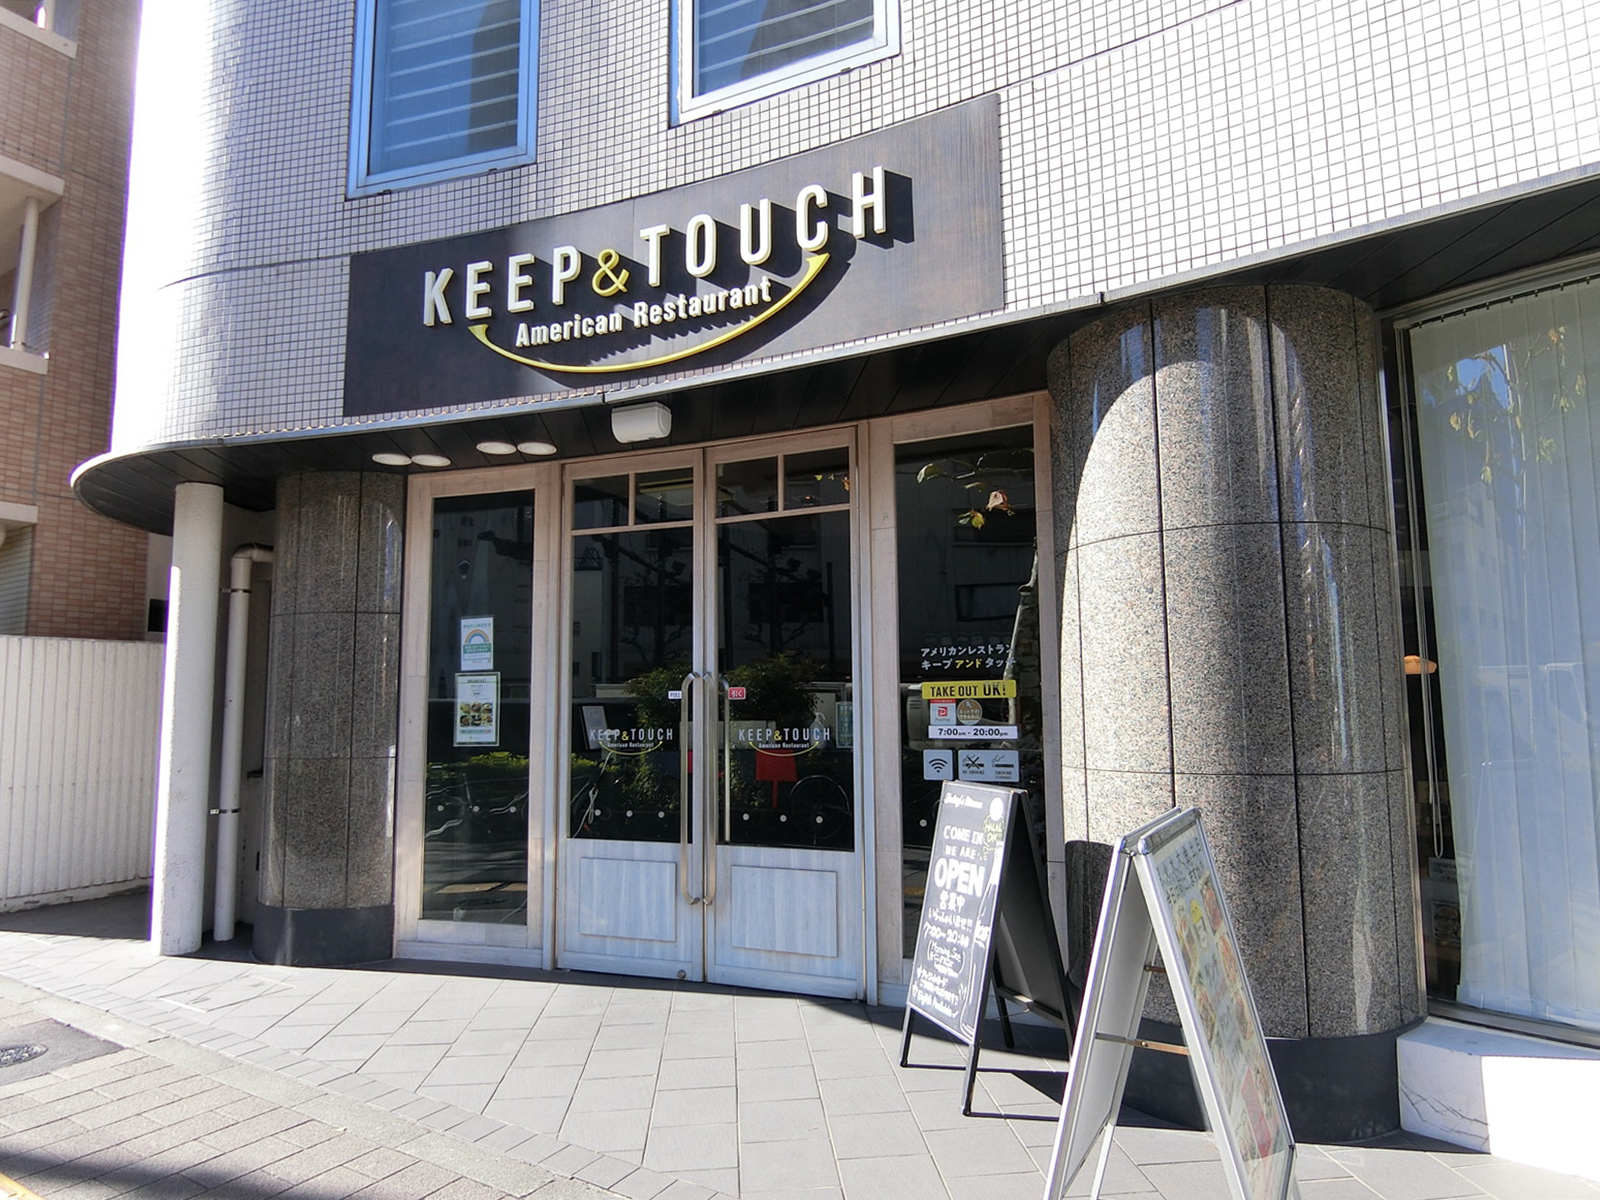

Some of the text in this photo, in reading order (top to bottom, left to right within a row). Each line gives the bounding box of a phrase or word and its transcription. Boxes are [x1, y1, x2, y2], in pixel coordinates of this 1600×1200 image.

[515, 276, 772, 348] American Restaurant
[921, 644, 1013, 657] アメリカンレストラン
[731, 689, 743, 698] 引く
[930, 686, 955, 697] TAKE
[958, 685, 978, 697] OUT
[973, 728, 1009, 737] 20:00pm
[943, 825, 971, 842] COME
[945, 845, 957, 856] WE
[934, 858, 985, 897] OPEN
